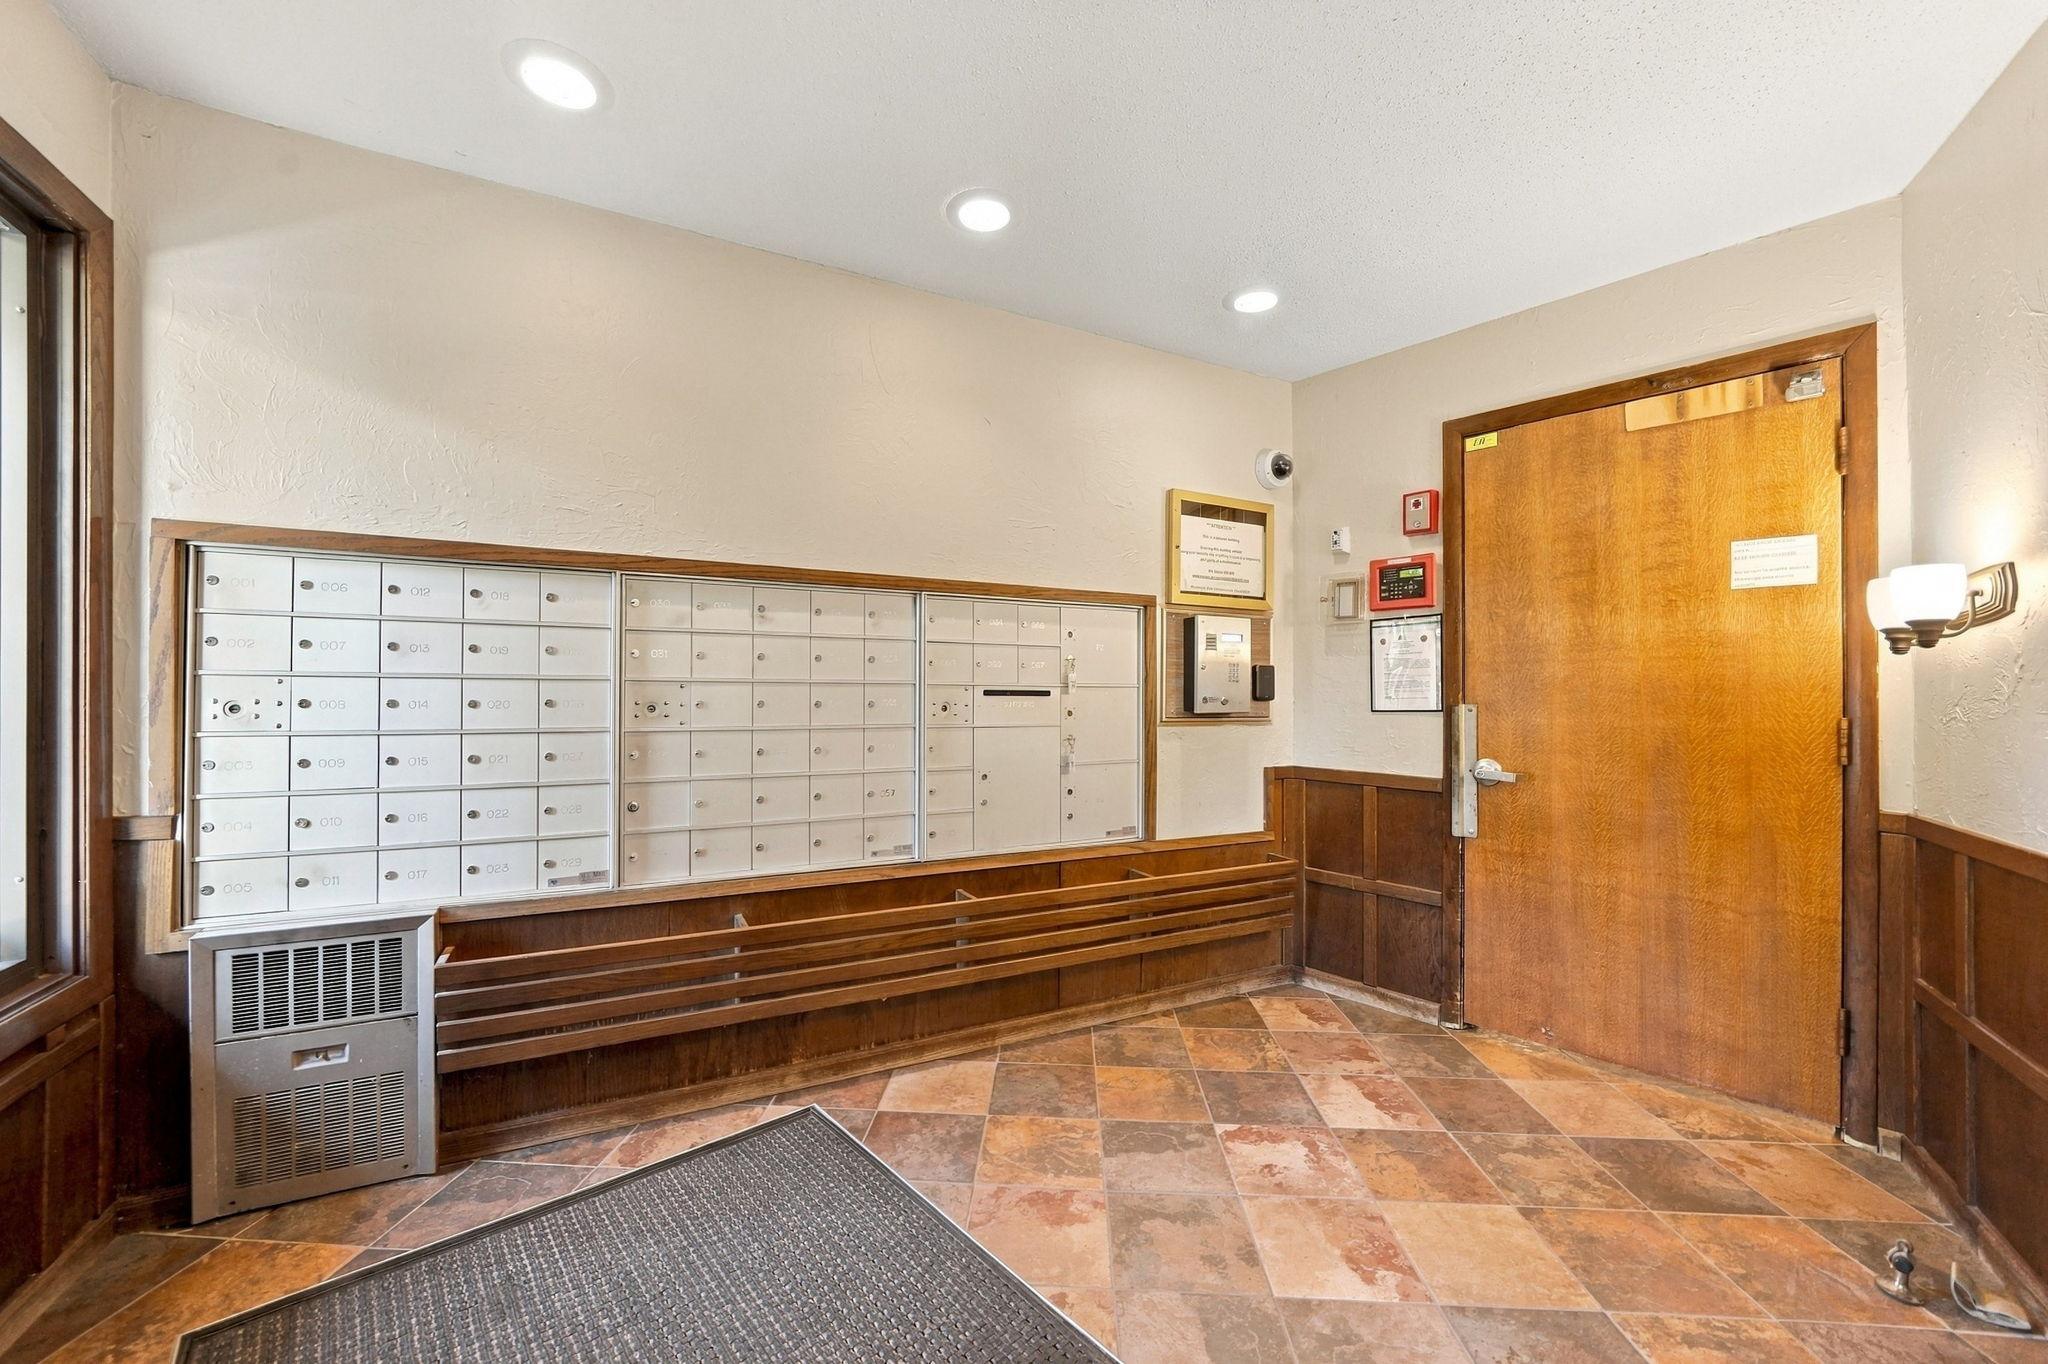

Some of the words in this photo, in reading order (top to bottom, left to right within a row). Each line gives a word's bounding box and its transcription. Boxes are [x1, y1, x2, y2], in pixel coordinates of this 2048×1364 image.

[230, 577, 256, 588] 001
[320, 582, 348, 593] 006
[410, 586, 431, 597] 012
[490, 591, 510, 601] 018
[226, 638, 256, 648] 002
[319, 640, 348, 651] 007
[409, 643, 430, 653] 013
[490, 645, 509, 656] 019
[318, 699, 347, 710] 008
[408, 700, 430, 710] 014
[486, 700, 511, 710] 020
[317, 758, 346, 769] 009
[407, 756, 429, 767] 015
[488, 755, 510, 764] 021
[486, 809, 510, 819] 022
[560, 805, 584, 815] 028
[320, 816, 343, 828] 010
[407, 812, 429, 823] 016
[486, 863, 510, 874] 023
[560, 858, 583, 868] 029
[407, 870, 429, 880] 017
[322, 876, 340, 887] 011
[222, 882, 254, 894] 005
